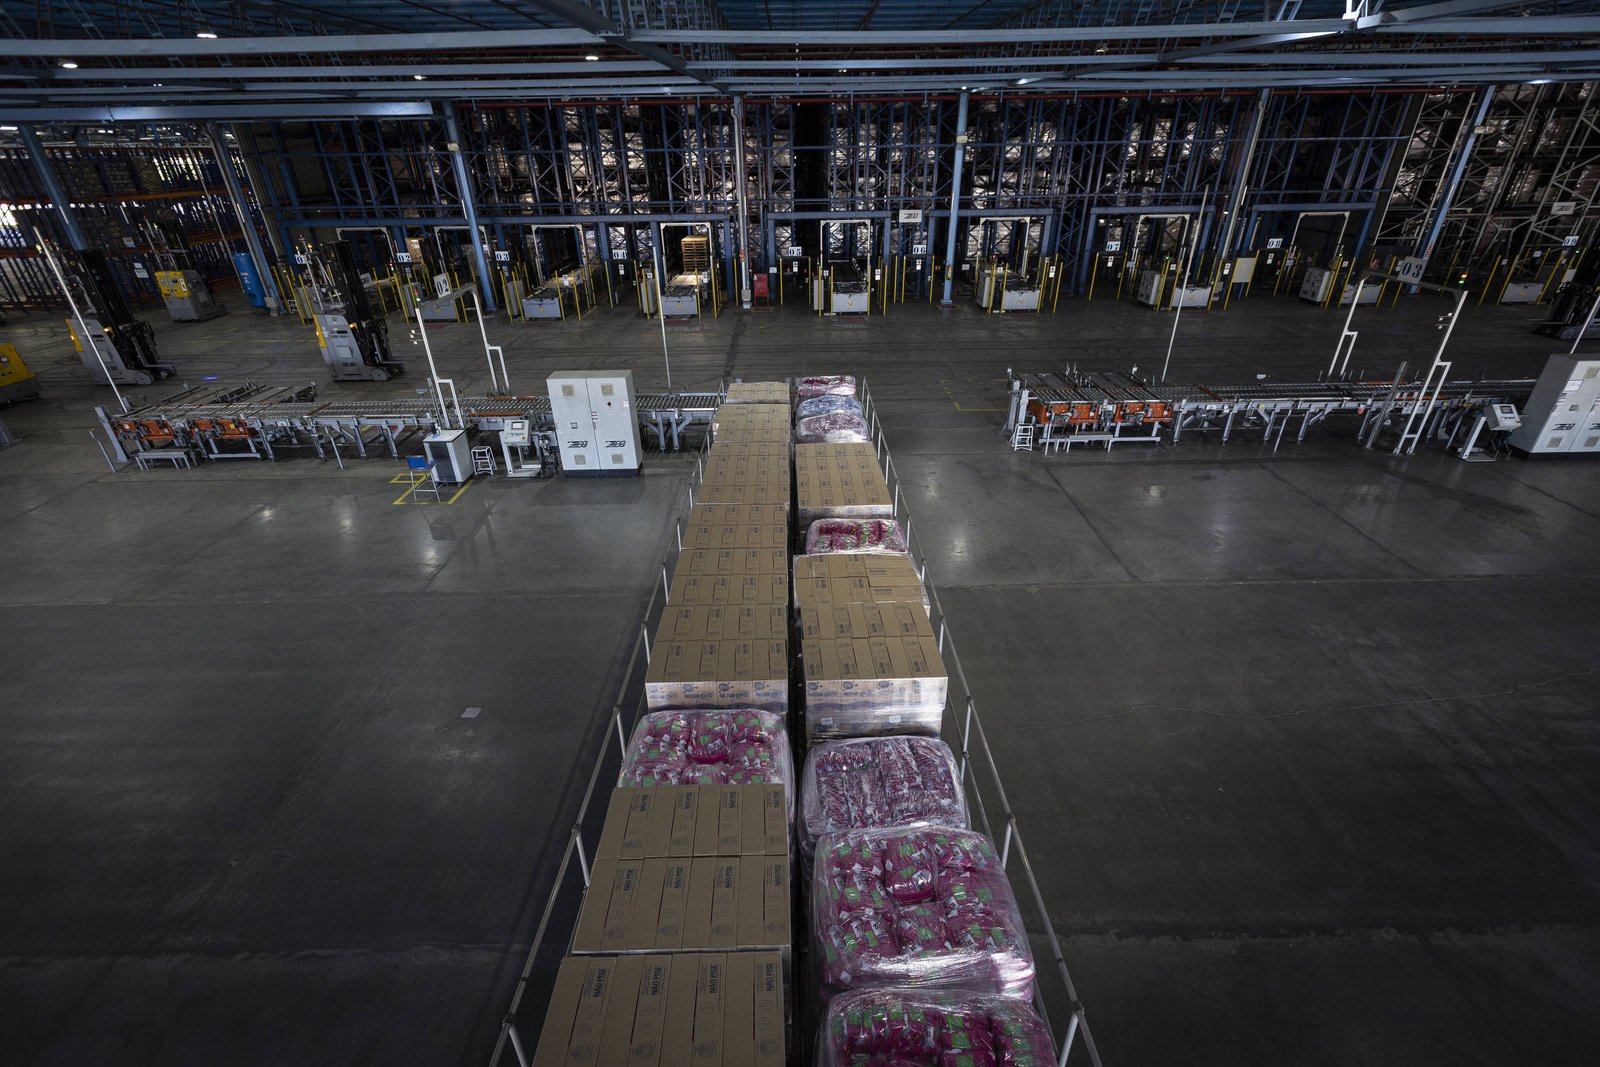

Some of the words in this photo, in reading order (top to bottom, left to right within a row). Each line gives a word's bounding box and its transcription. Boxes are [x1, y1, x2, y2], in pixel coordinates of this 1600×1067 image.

[790, 248, 801, 256] 05
[1402, 262, 1422, 278] 03
[436, 279, 449, 295] 02
[596, 968, 606, 982] PISE
[653, 966, 662, 980] PISE
[592, 983, 603, 997] NÃO
[650, 981, 660, 995] NÃO
